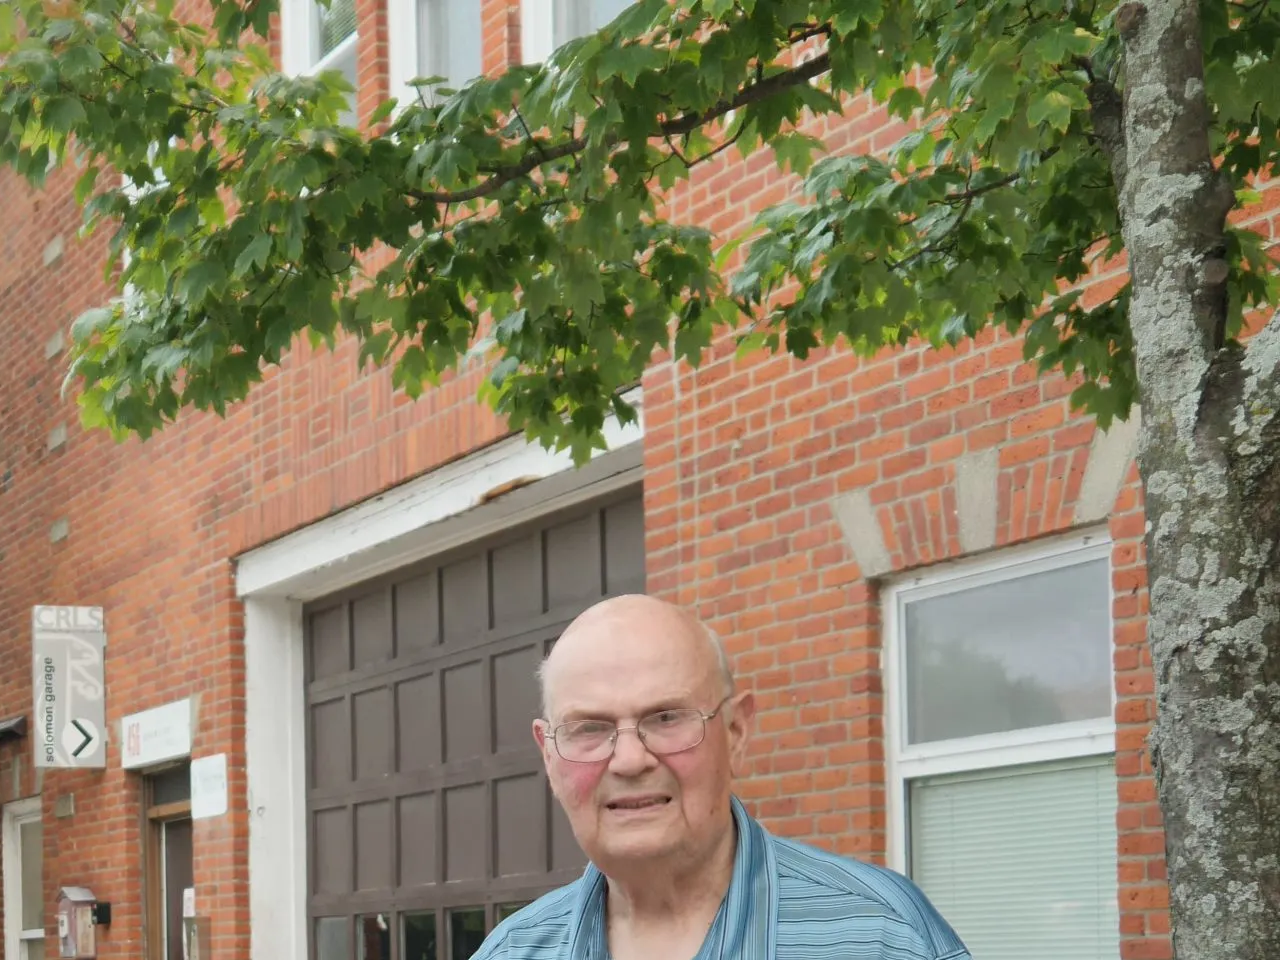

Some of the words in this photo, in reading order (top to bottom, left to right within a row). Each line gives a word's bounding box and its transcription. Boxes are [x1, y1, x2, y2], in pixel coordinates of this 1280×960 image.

[35, 605, 102, 629] CRLS
[43, 657, 55, 702] garage
[44, 706, 55, 763] solomon
